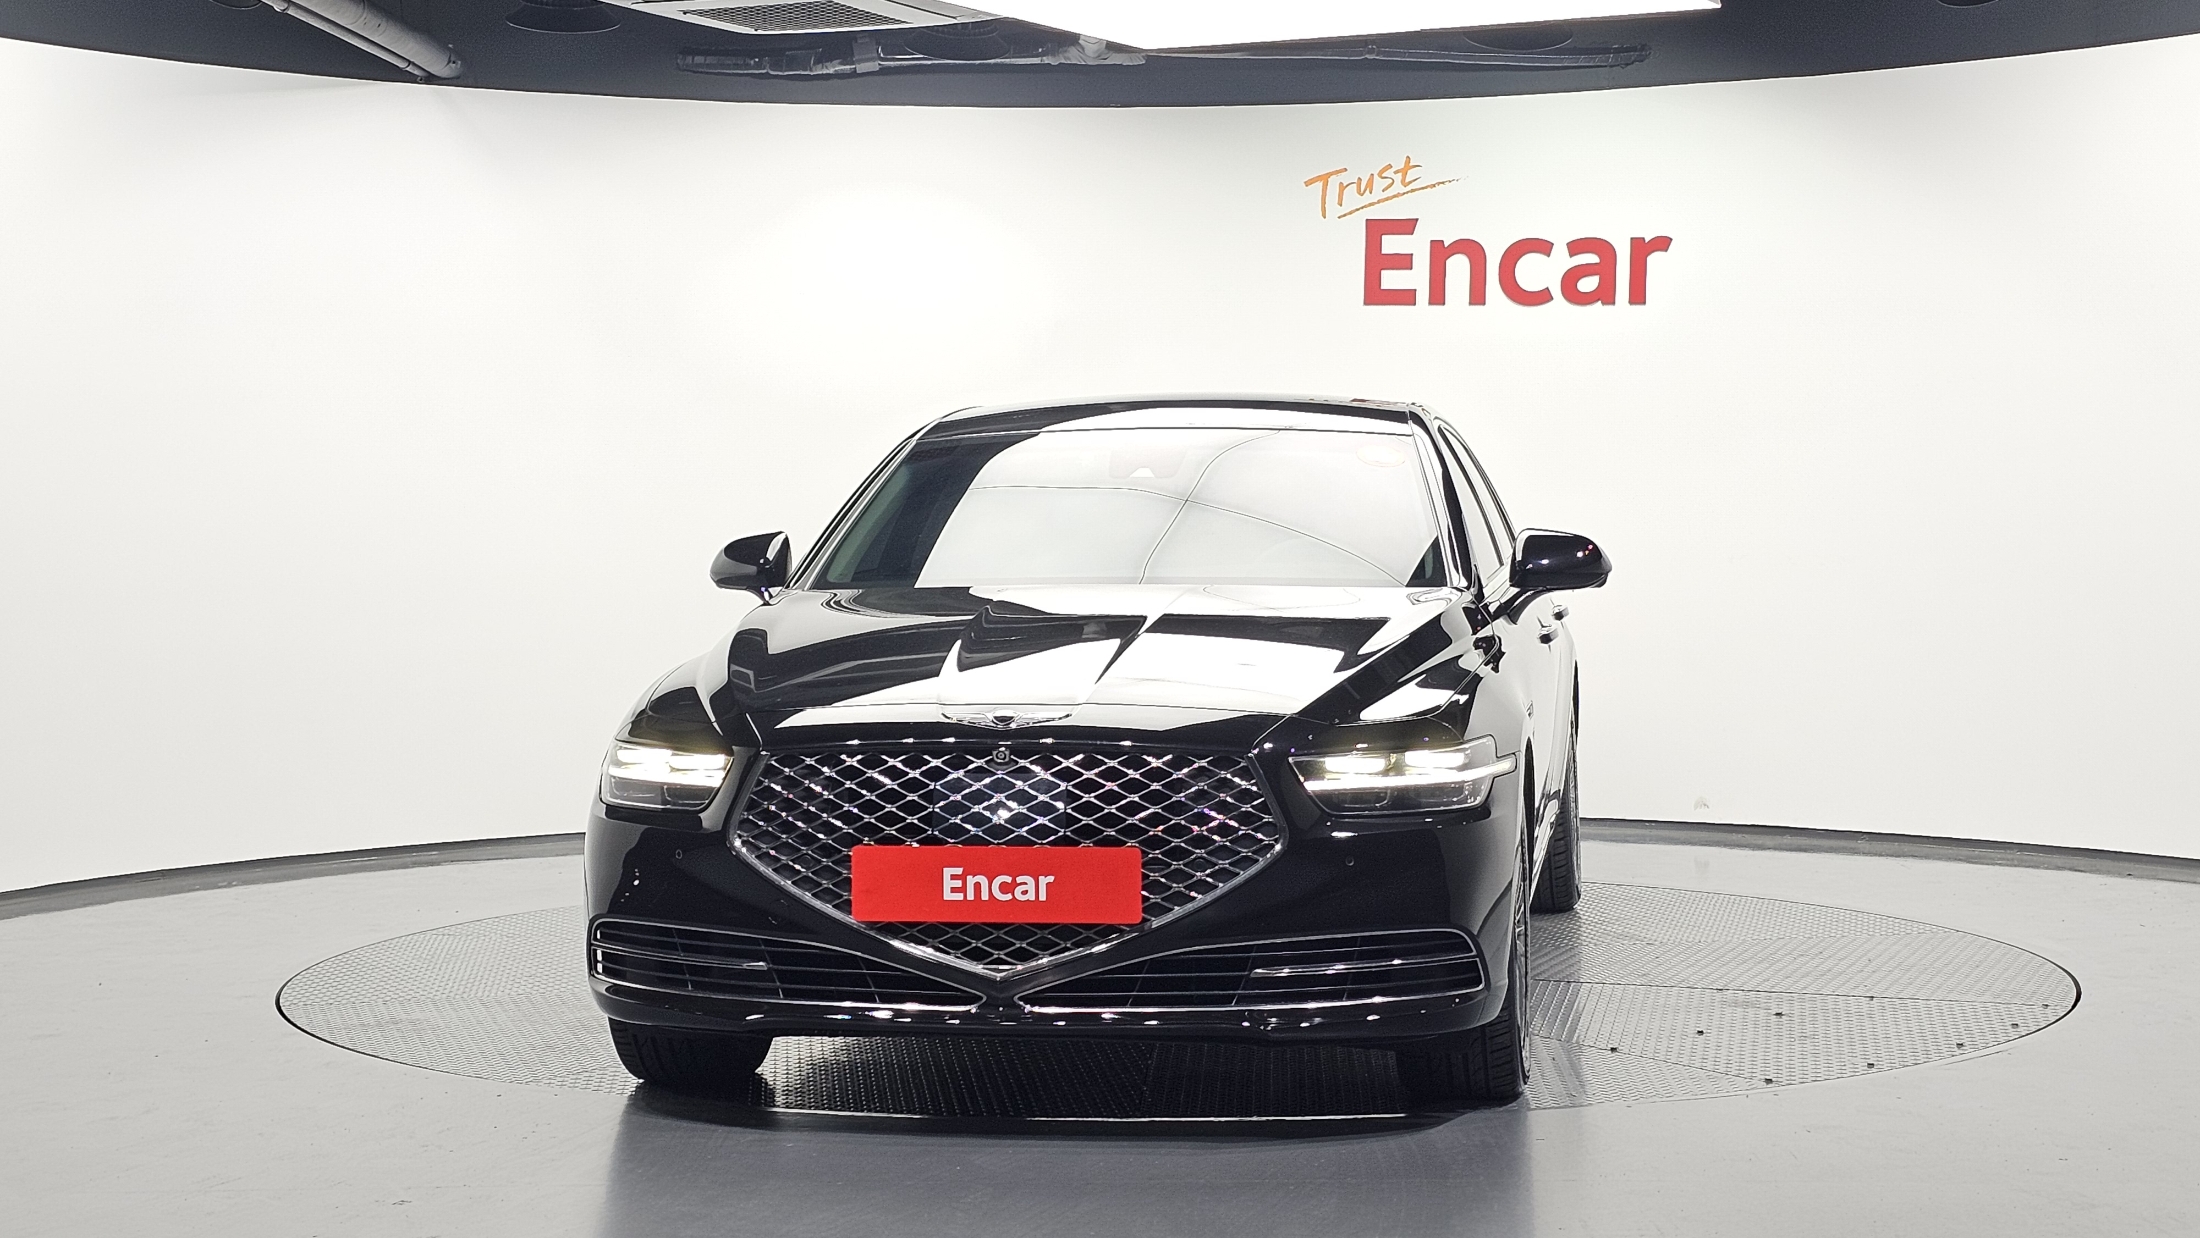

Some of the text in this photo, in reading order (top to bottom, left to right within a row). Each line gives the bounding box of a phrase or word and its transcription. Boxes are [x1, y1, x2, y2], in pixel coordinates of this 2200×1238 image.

[1304, 155, 1422, 219] Trust
[1363, 218, 1673, 306] Encar
[943, 867, 1055, 901] Encar
